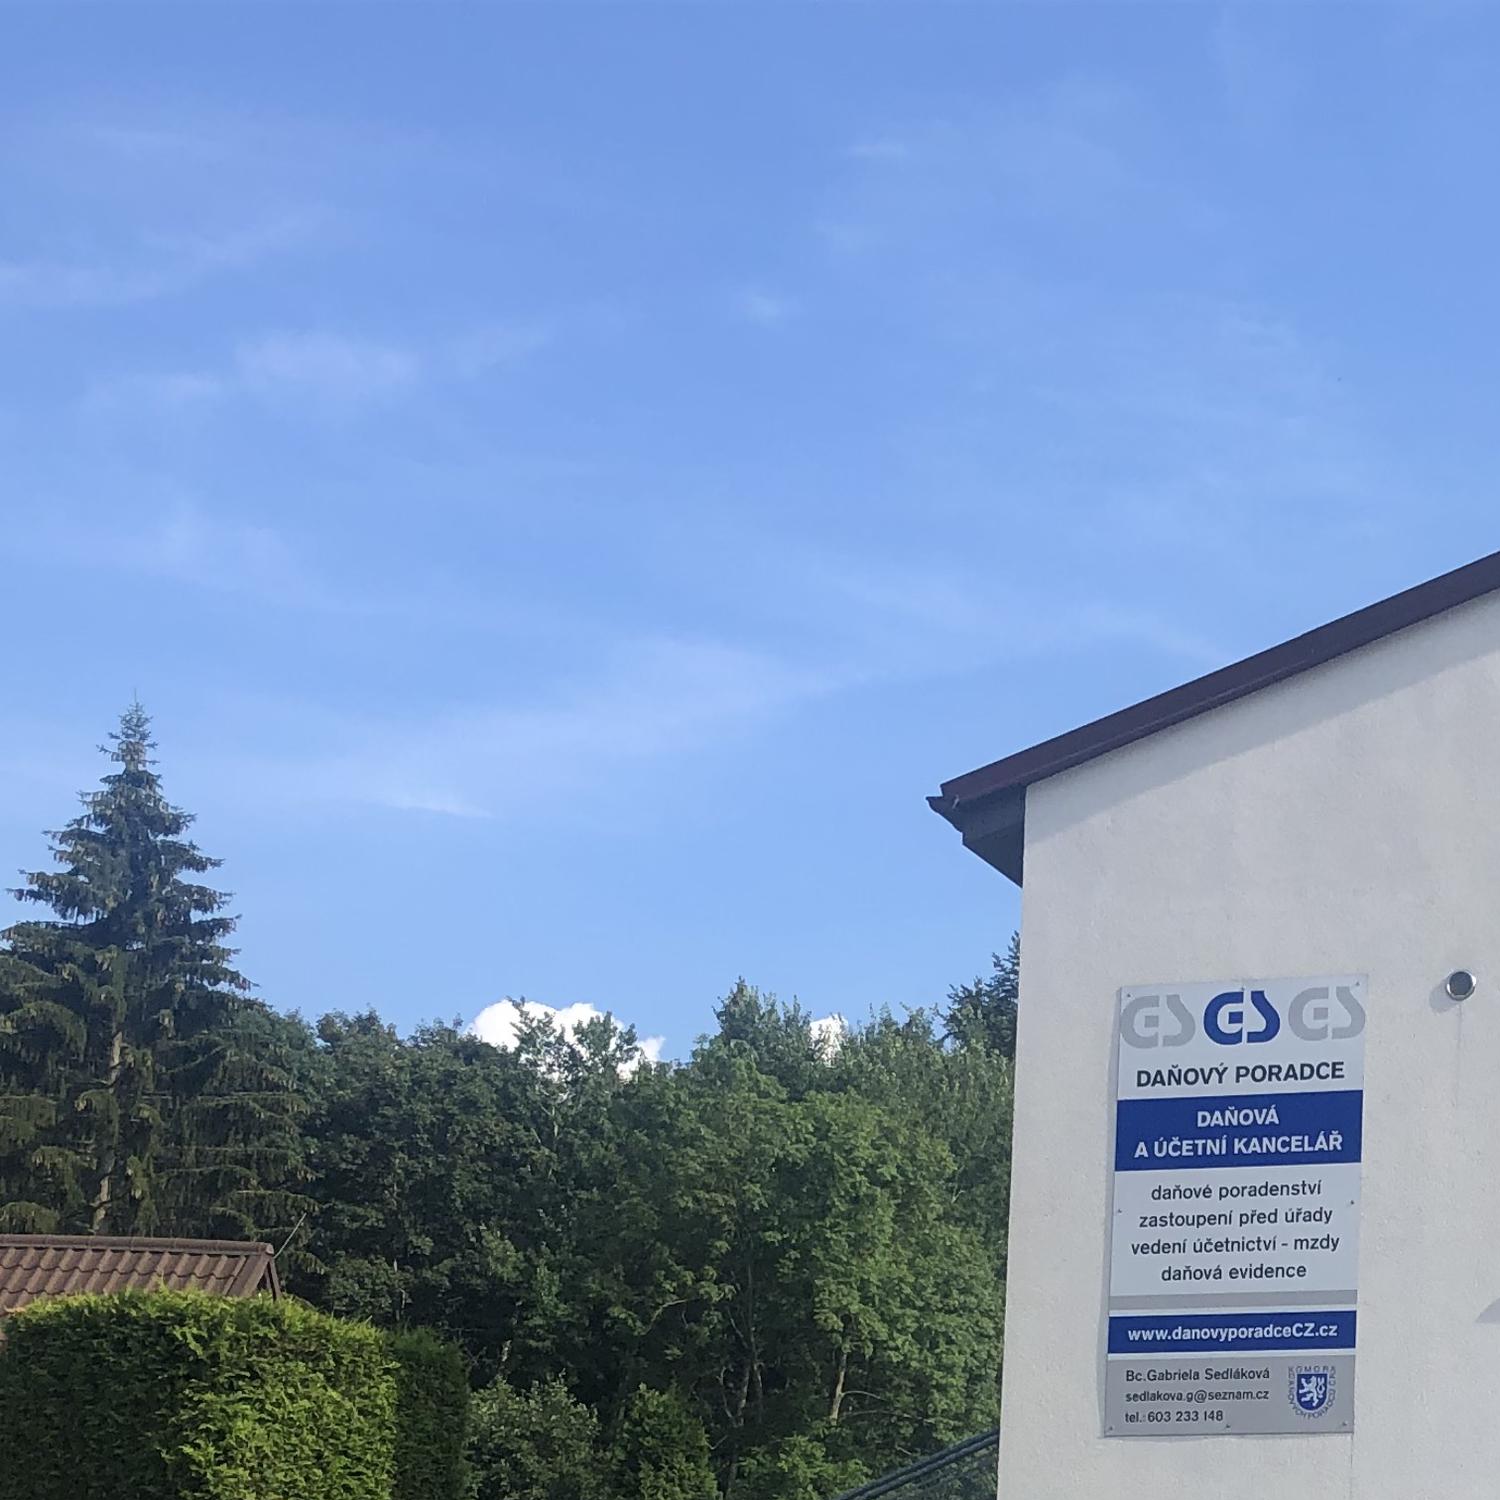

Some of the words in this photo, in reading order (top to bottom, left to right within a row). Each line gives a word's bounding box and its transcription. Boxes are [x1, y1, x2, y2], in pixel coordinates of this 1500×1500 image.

[1136, 1062, 1228, 1088] DAŇOVÝ
[1235, 1061, 1345, 1084] PORADCE
[1197, 1104, 1279, 1128] DAŇOVÁ
[1134, 1141, 1149, 1159] A
[1154, 1134, 1227, 1158] ÚČETNÍ
[1233, 1130, 1343, 1155] KANCELÁŘ
[1151, 1183, 1213, 1201] daňové
[1218, 1179, 1322, 1201] poradenství
[1139, 1210, 1233, 1229] zastoupení
[1239, 1207, 1278, 1228] před
[1285, 1206, 1333, 1225] úřady
[1131, 1238, 1187, 1256] vedení
[1193, 1235, 1277, 1254] účetnictví
[1293, 1233, 1340, 1252] mzdy
[1161, 1264, 1222, 1282] daňová
[1229, 1263, 1307, 1279] evidence
[1127, 1322, 1338, 1342] www.danovyporadceCZ.cz
[1204, 1367, 1270, 1381] Sedláková
[1125, 1389, 1270, 1404] sedlakova.g@seznam.cz
[1147, 1411, 1171, 1423] 603
[1175, 1410, 1199, 1422] 233
[1203, 1410, 1224, 1422] 148
